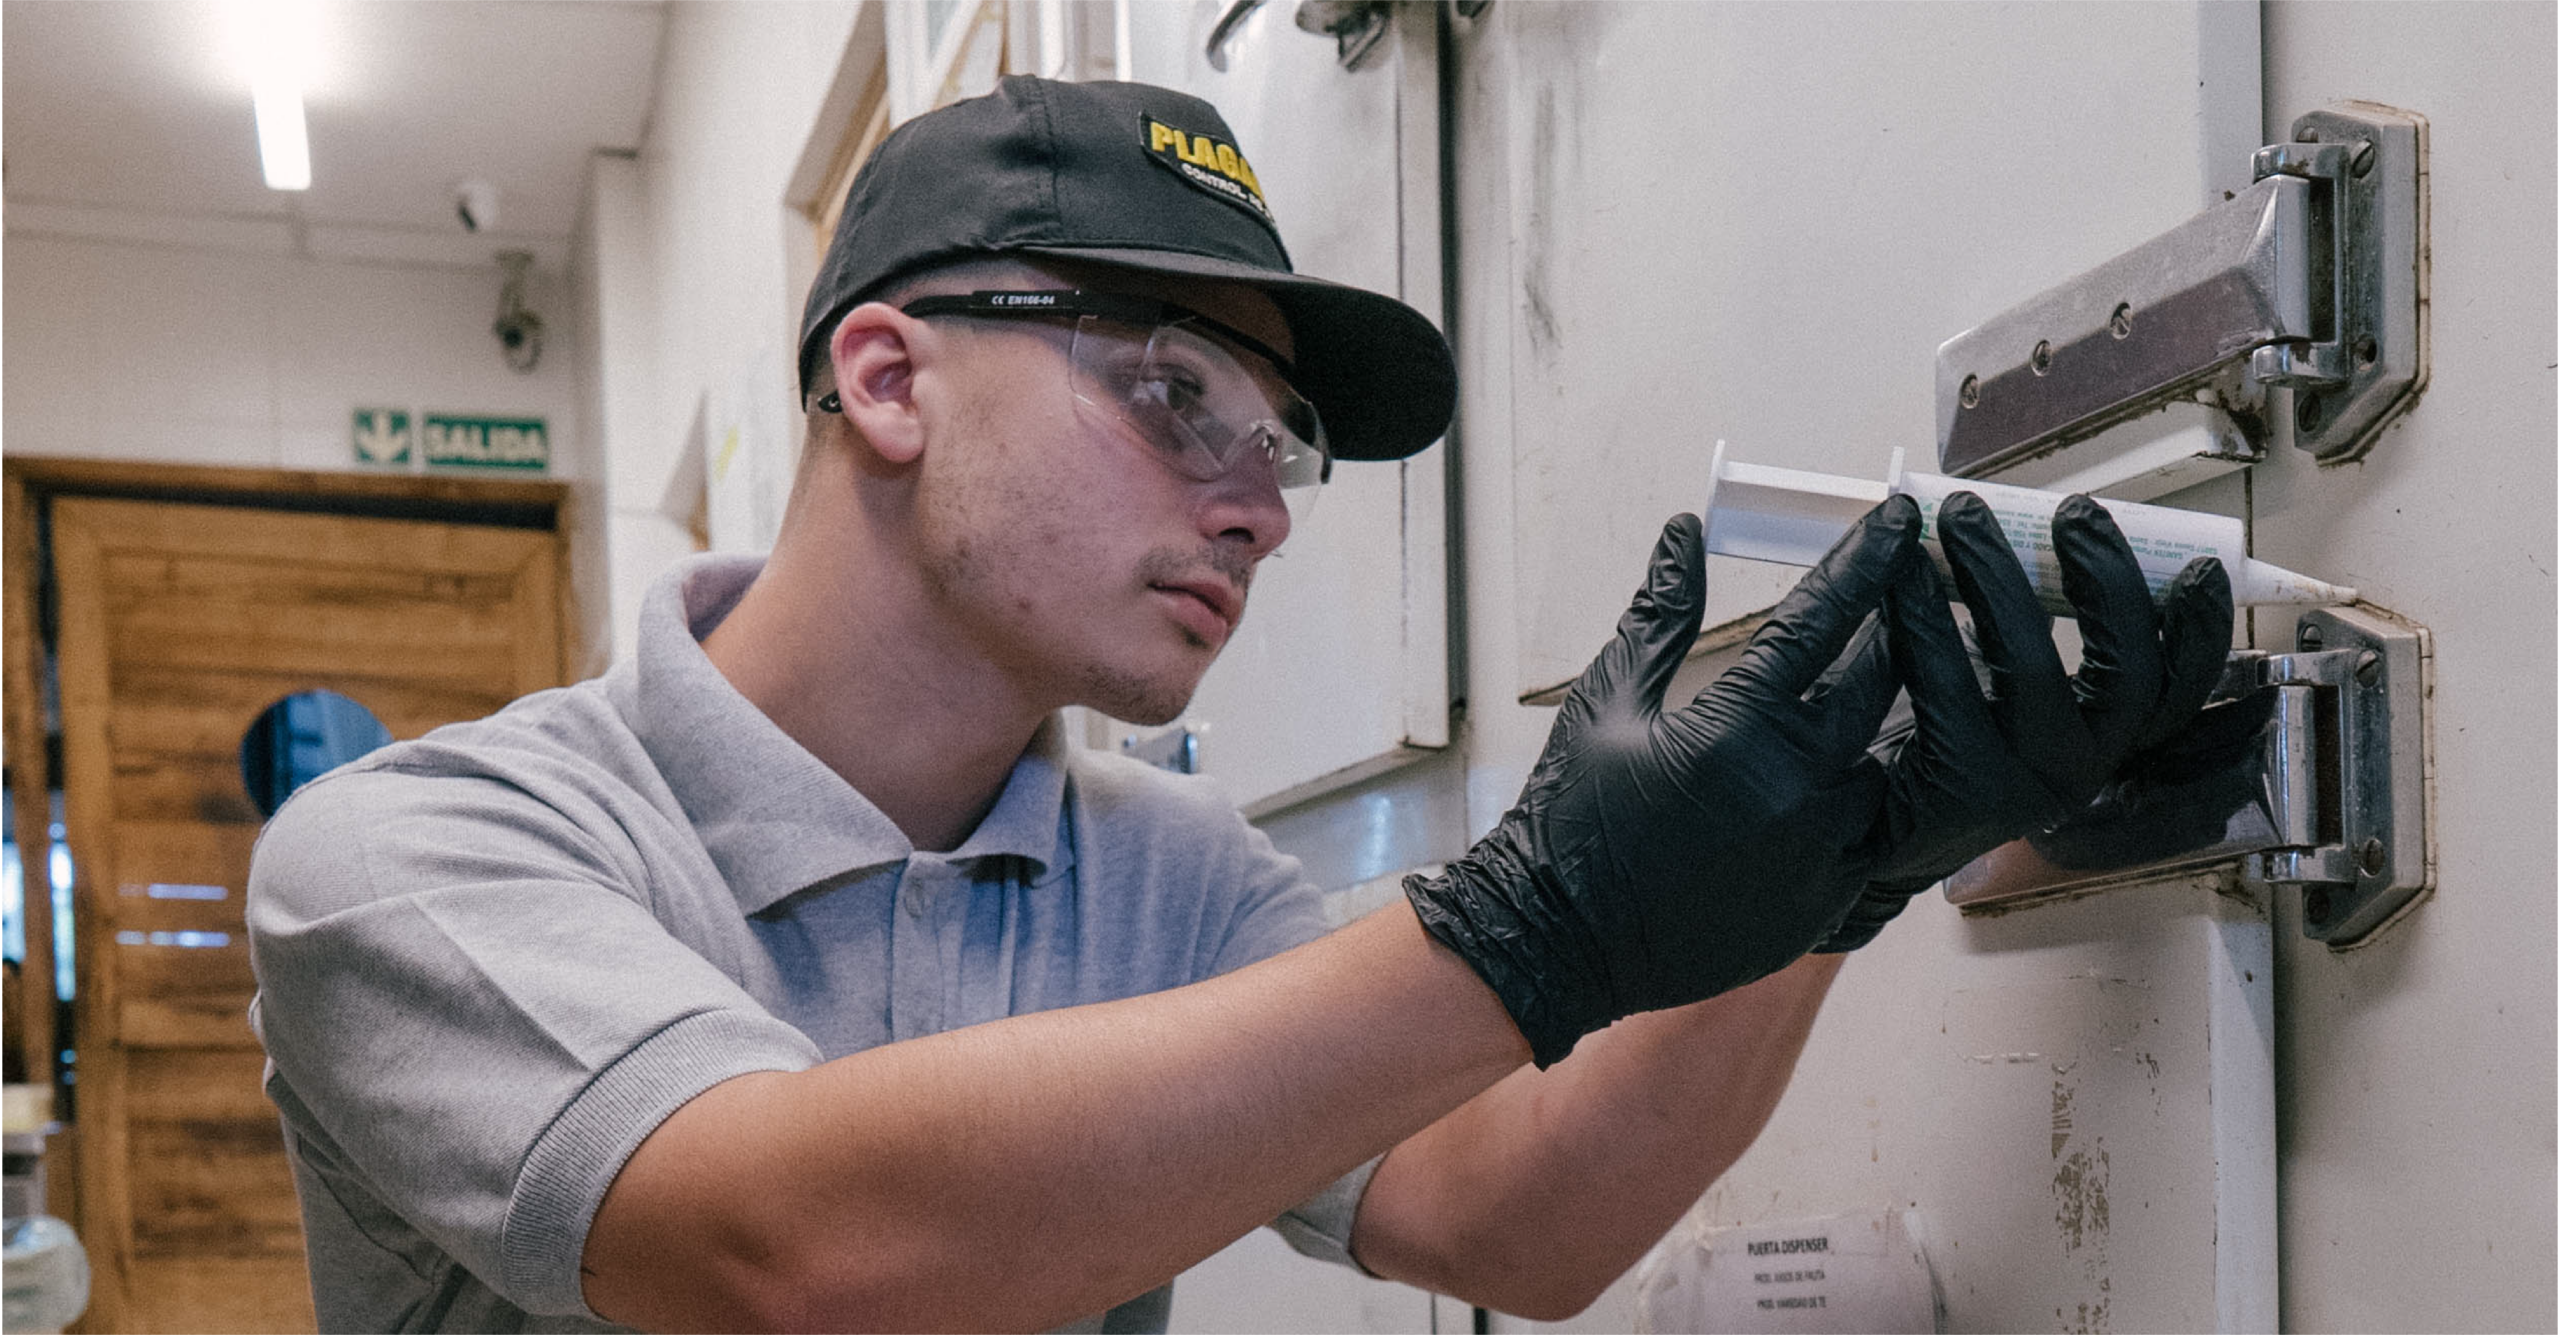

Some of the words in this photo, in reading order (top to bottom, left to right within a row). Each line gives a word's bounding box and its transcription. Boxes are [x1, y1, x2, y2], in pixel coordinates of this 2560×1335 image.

[427, 425, 547, 462] SALIDA
[1748, 1241, 1779, 1256] PUERTA
[1782, 1237, 1828, 1254] DISPENSER
